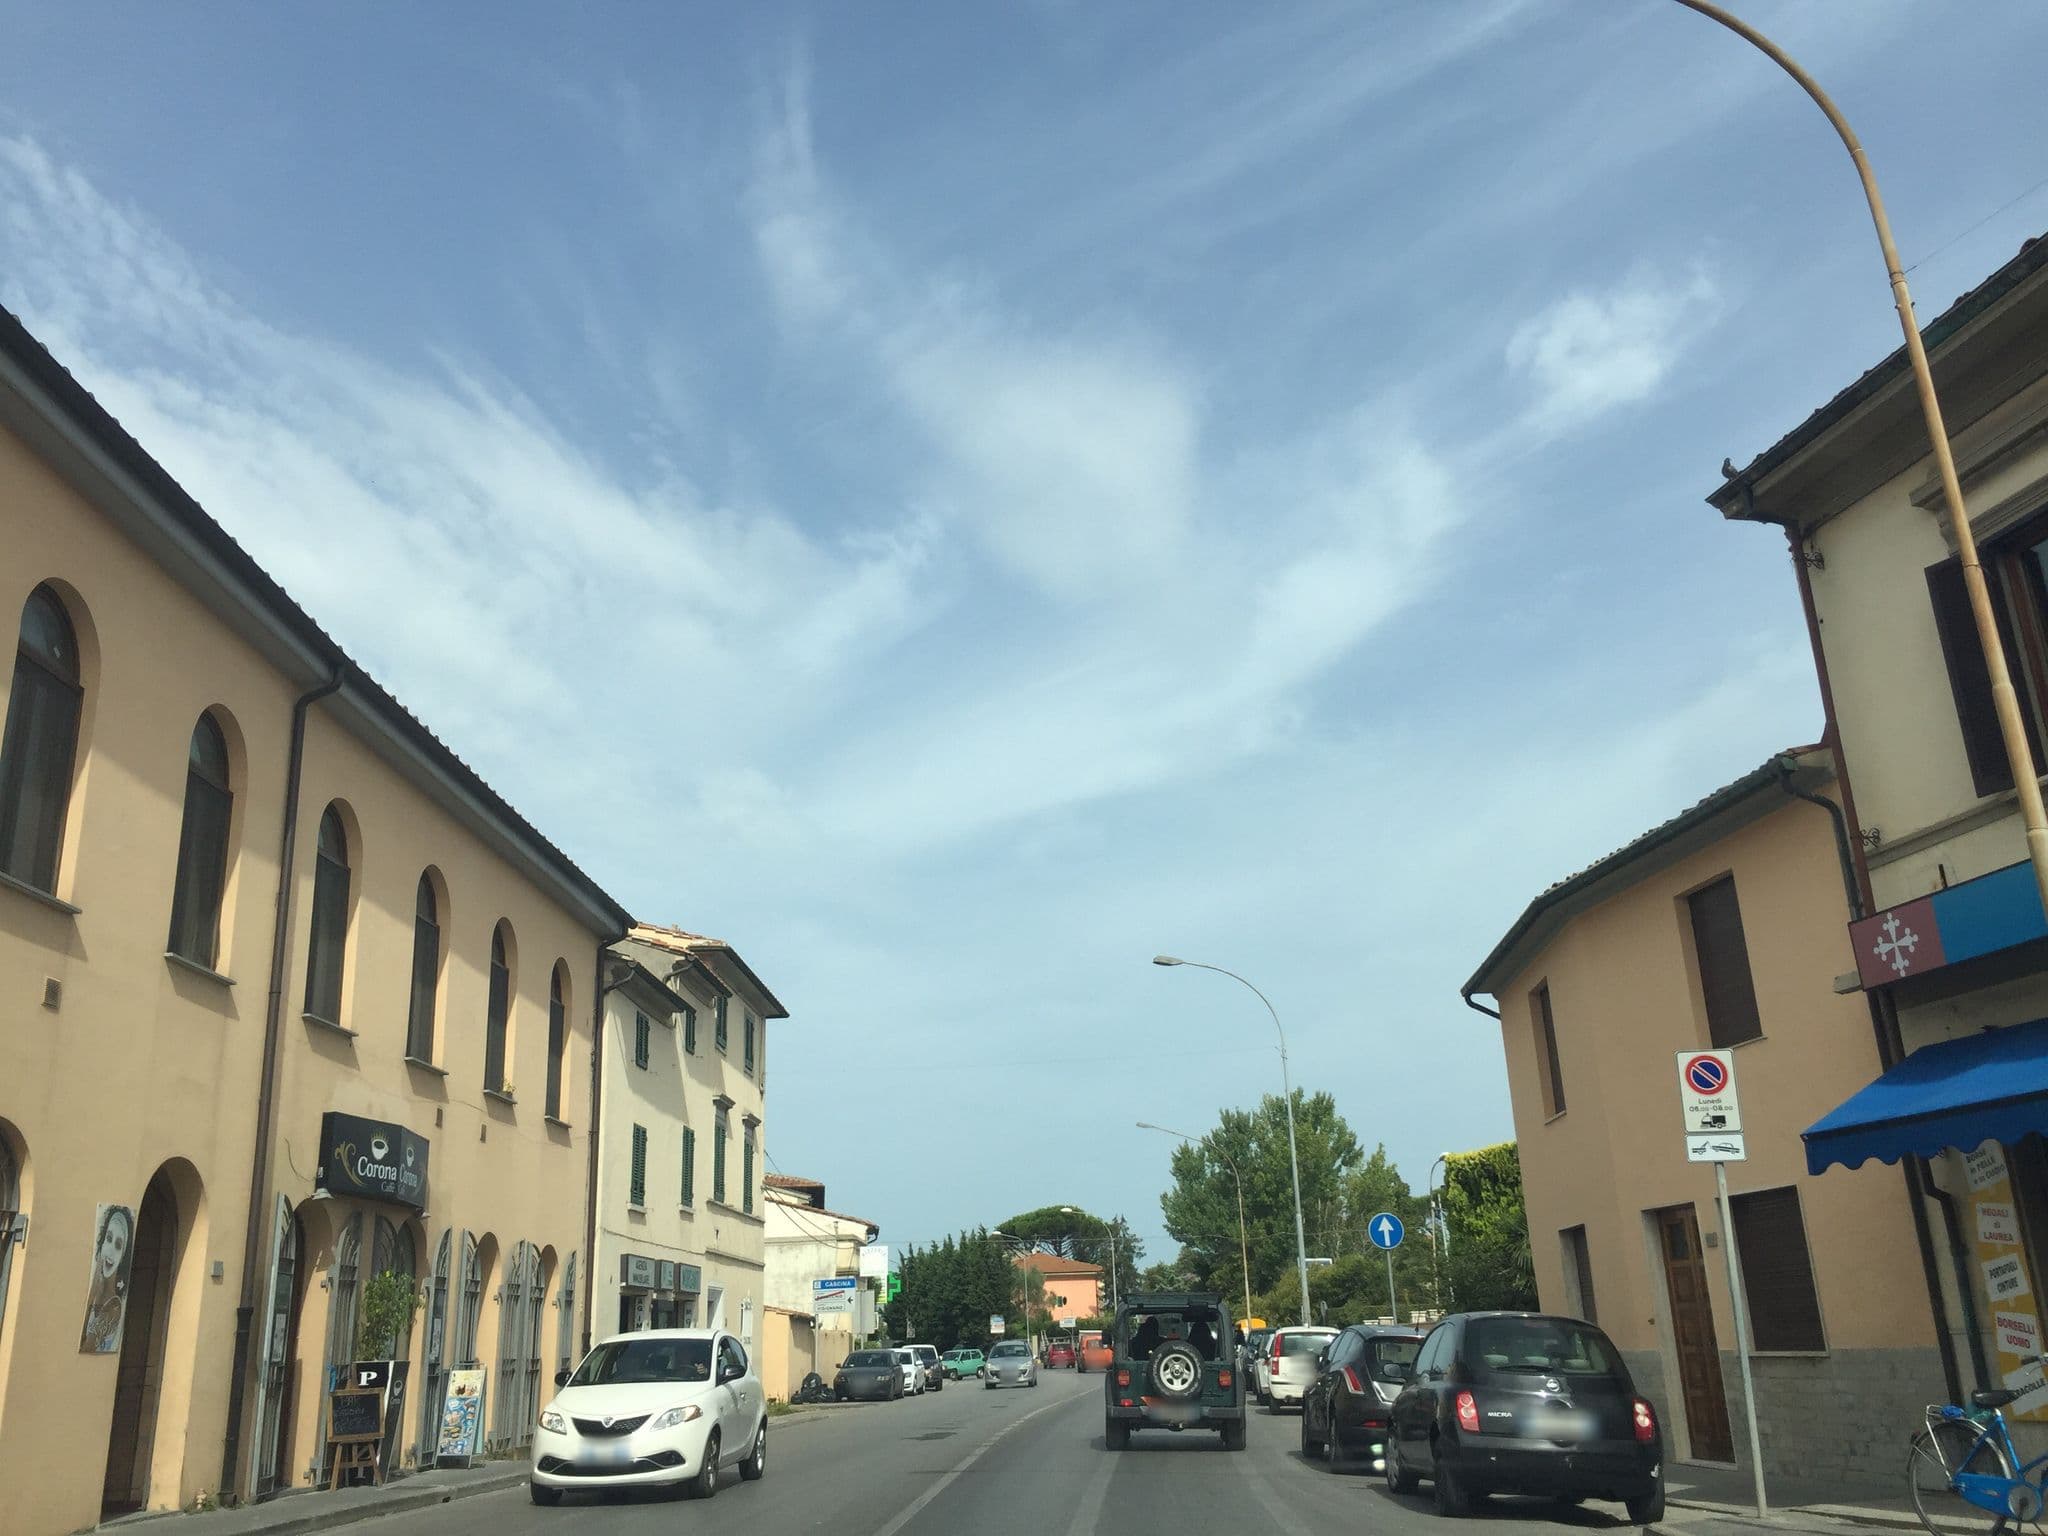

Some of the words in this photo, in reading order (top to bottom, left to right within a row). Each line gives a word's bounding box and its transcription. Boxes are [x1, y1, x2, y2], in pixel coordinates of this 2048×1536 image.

[358, 1156, 398, 1181] Corona
[1982, 1207, 2009, 1218] REGALI
[1983, 1231, 2014, 1242] LAUREA
[824, 1280, 852, 1288] CASCINA
[1997, 1317, 2035, 1335] BORSELLI
[2006, 1335, 2031, 1349] UOMO
